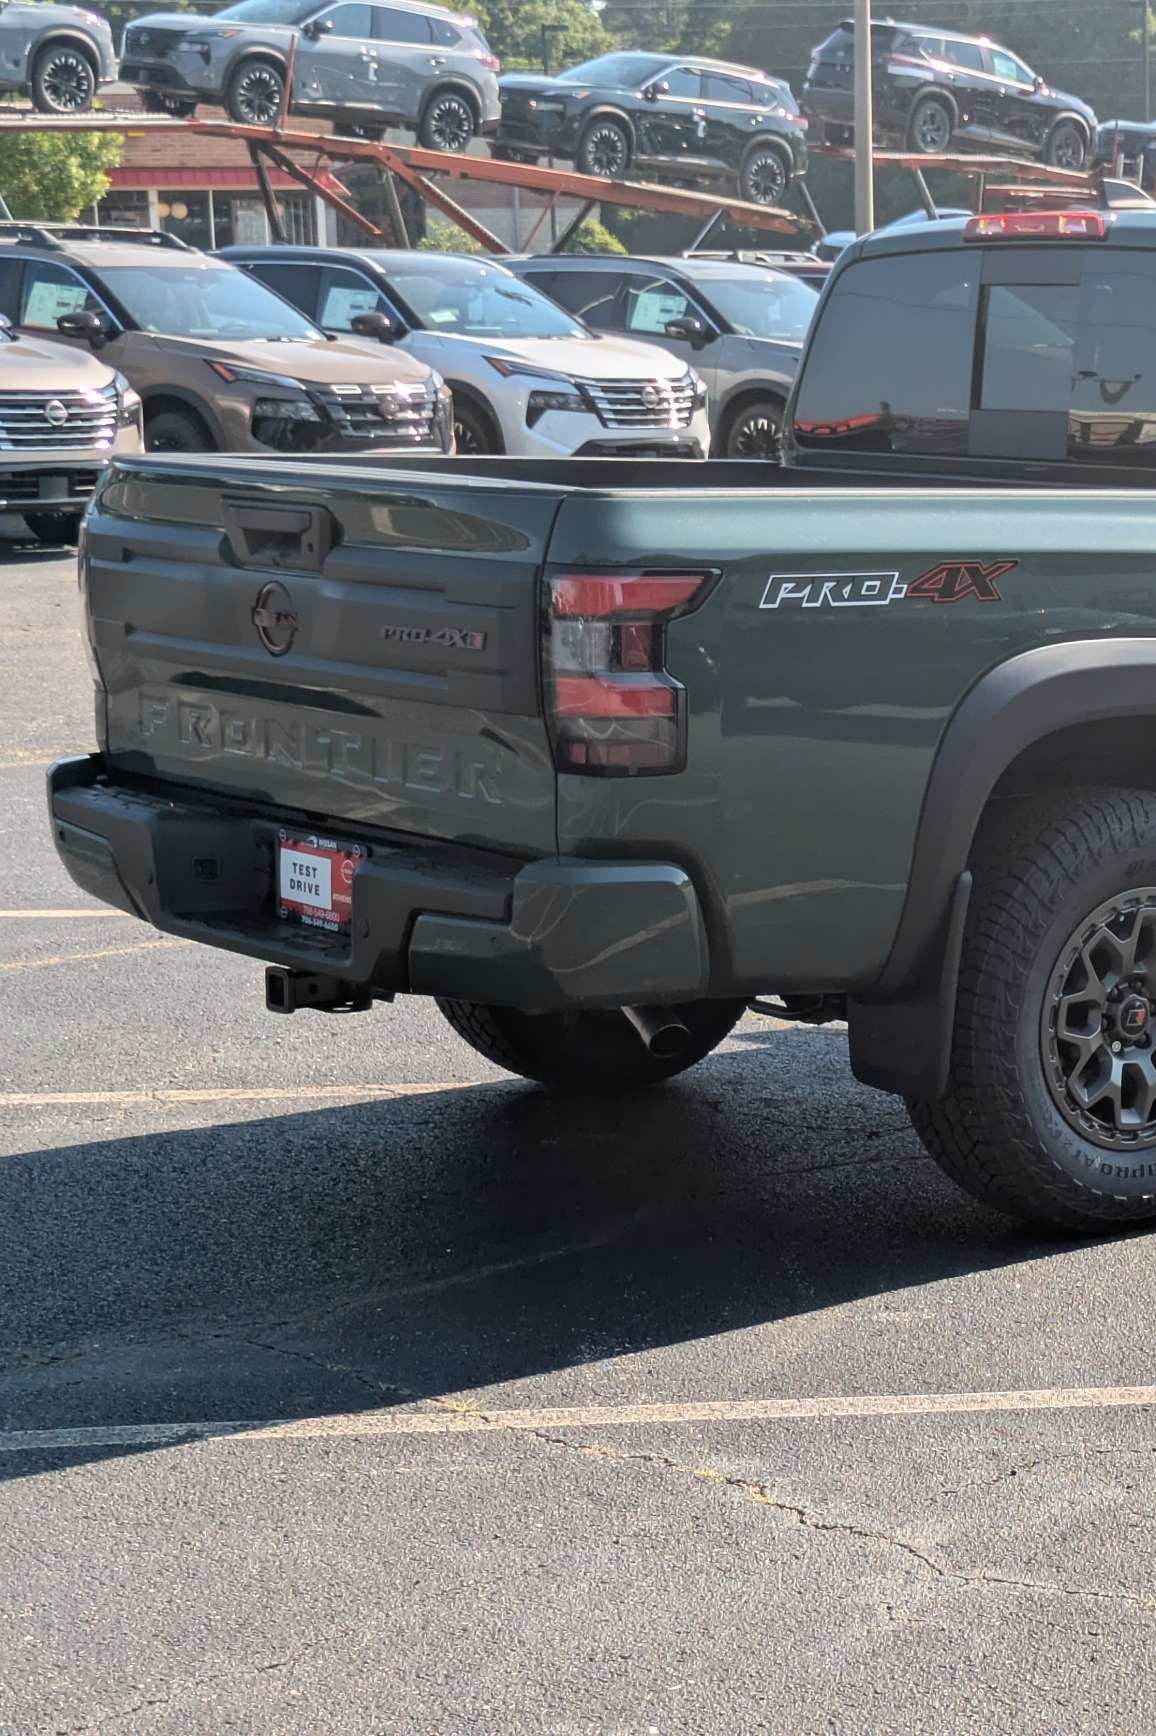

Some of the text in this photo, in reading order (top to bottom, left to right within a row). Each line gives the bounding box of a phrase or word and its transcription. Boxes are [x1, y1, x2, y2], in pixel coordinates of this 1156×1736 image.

[758, 558, 1019, 609] PRO-4X
[140, 692, 502, 804] FRONTIER
[289, 878, 320, 896] DRIVE
[292, 862, 318, 879] TEST
